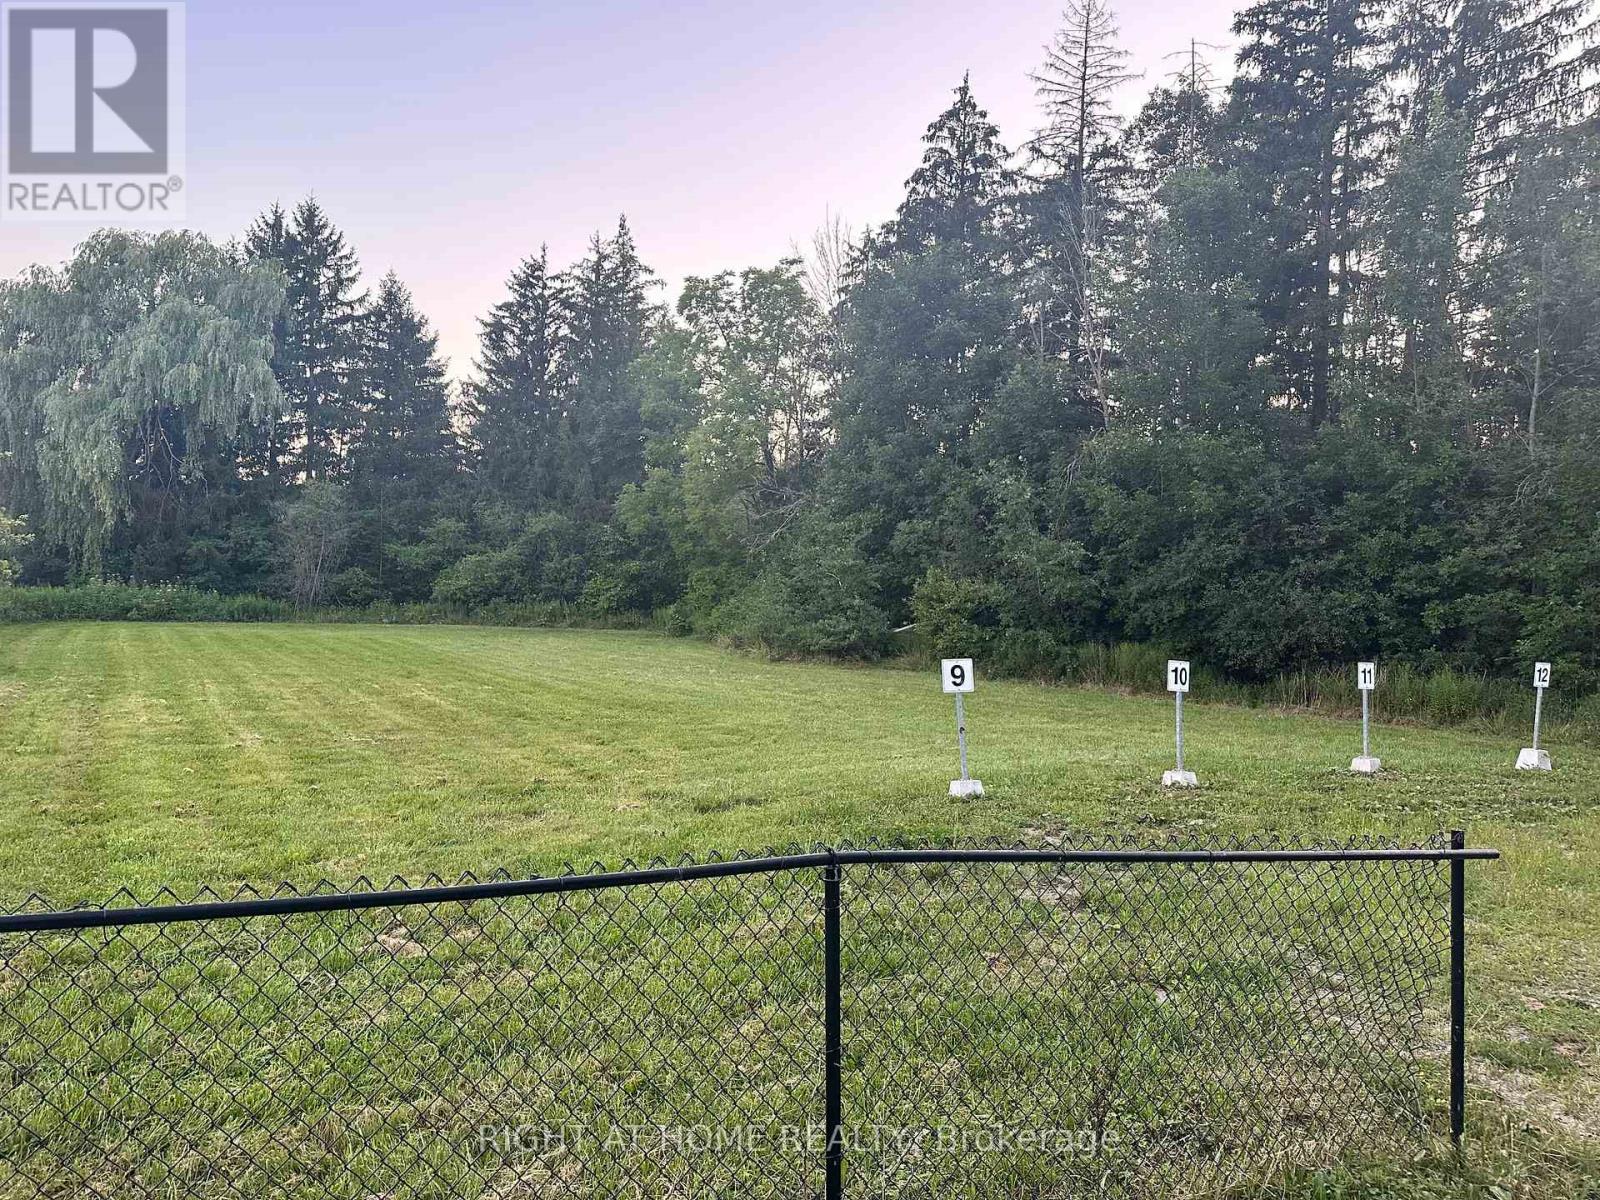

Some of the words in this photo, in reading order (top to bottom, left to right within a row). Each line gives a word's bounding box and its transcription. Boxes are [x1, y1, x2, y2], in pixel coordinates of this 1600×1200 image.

[950, 664, 966, 687] 9
[1170, 666, 1188, 686] 10
[1361, 667, 1372, 684] 11
[1536, 667, 1549, 683] 12
